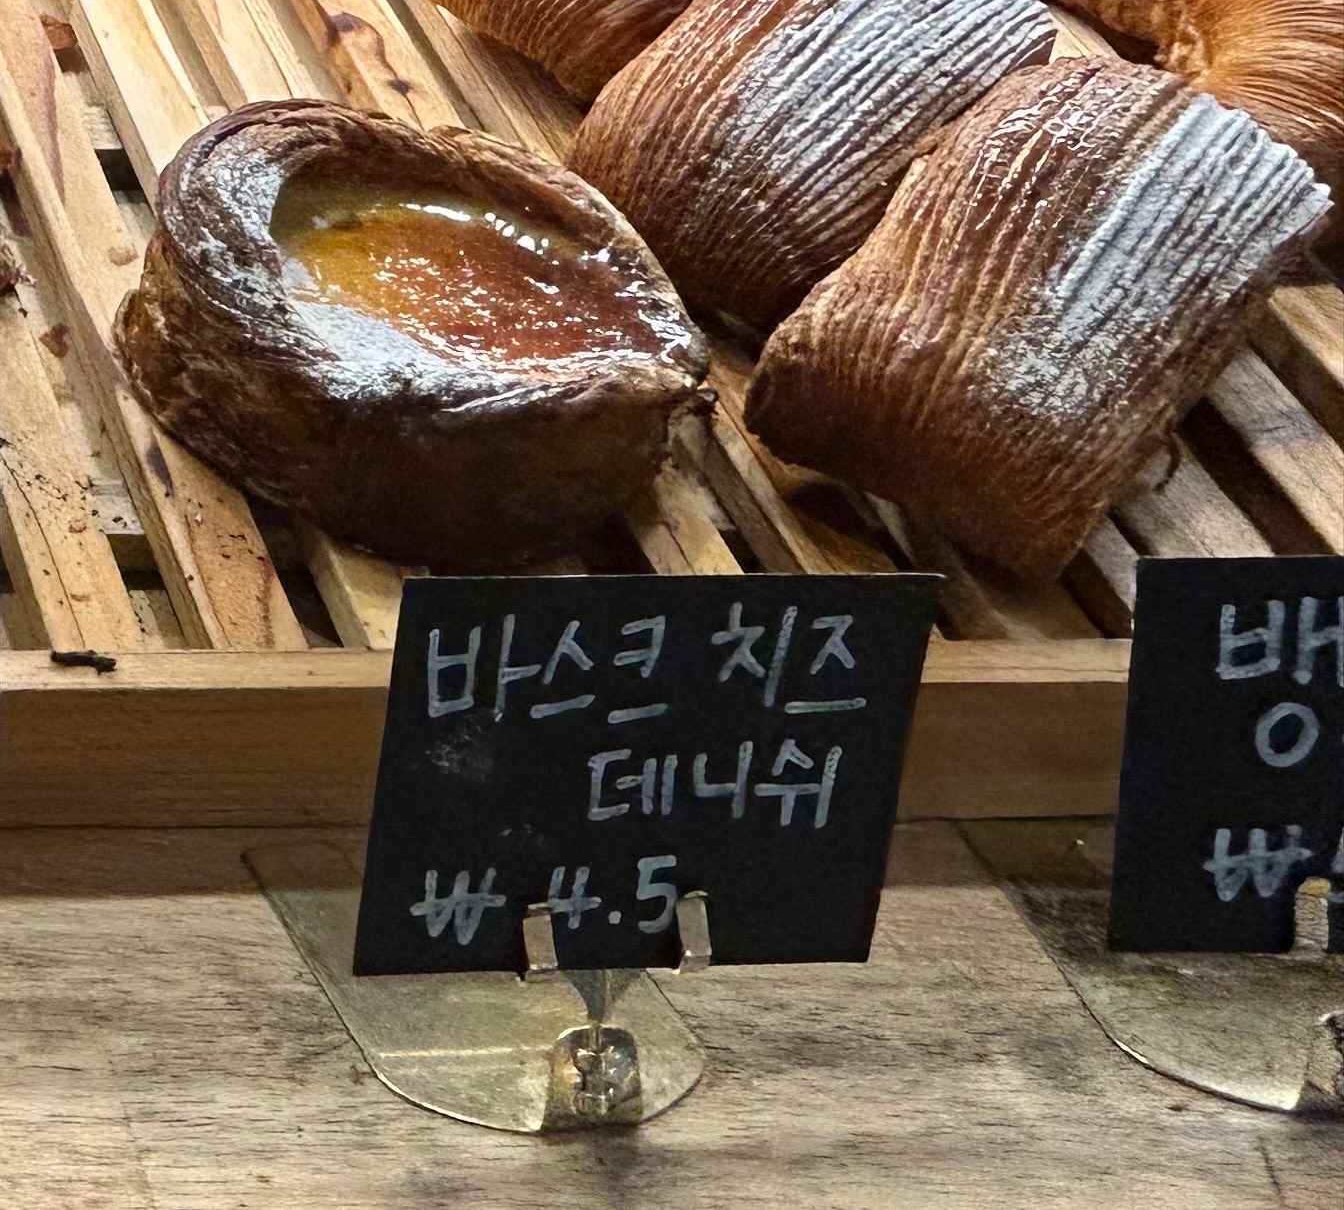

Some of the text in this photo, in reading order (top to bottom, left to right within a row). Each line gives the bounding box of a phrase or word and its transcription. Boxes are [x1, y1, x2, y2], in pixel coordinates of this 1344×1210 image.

[427, 602, 866, 724] 바스크 치즈
[587, 739, 843, 828] 데니쉬
